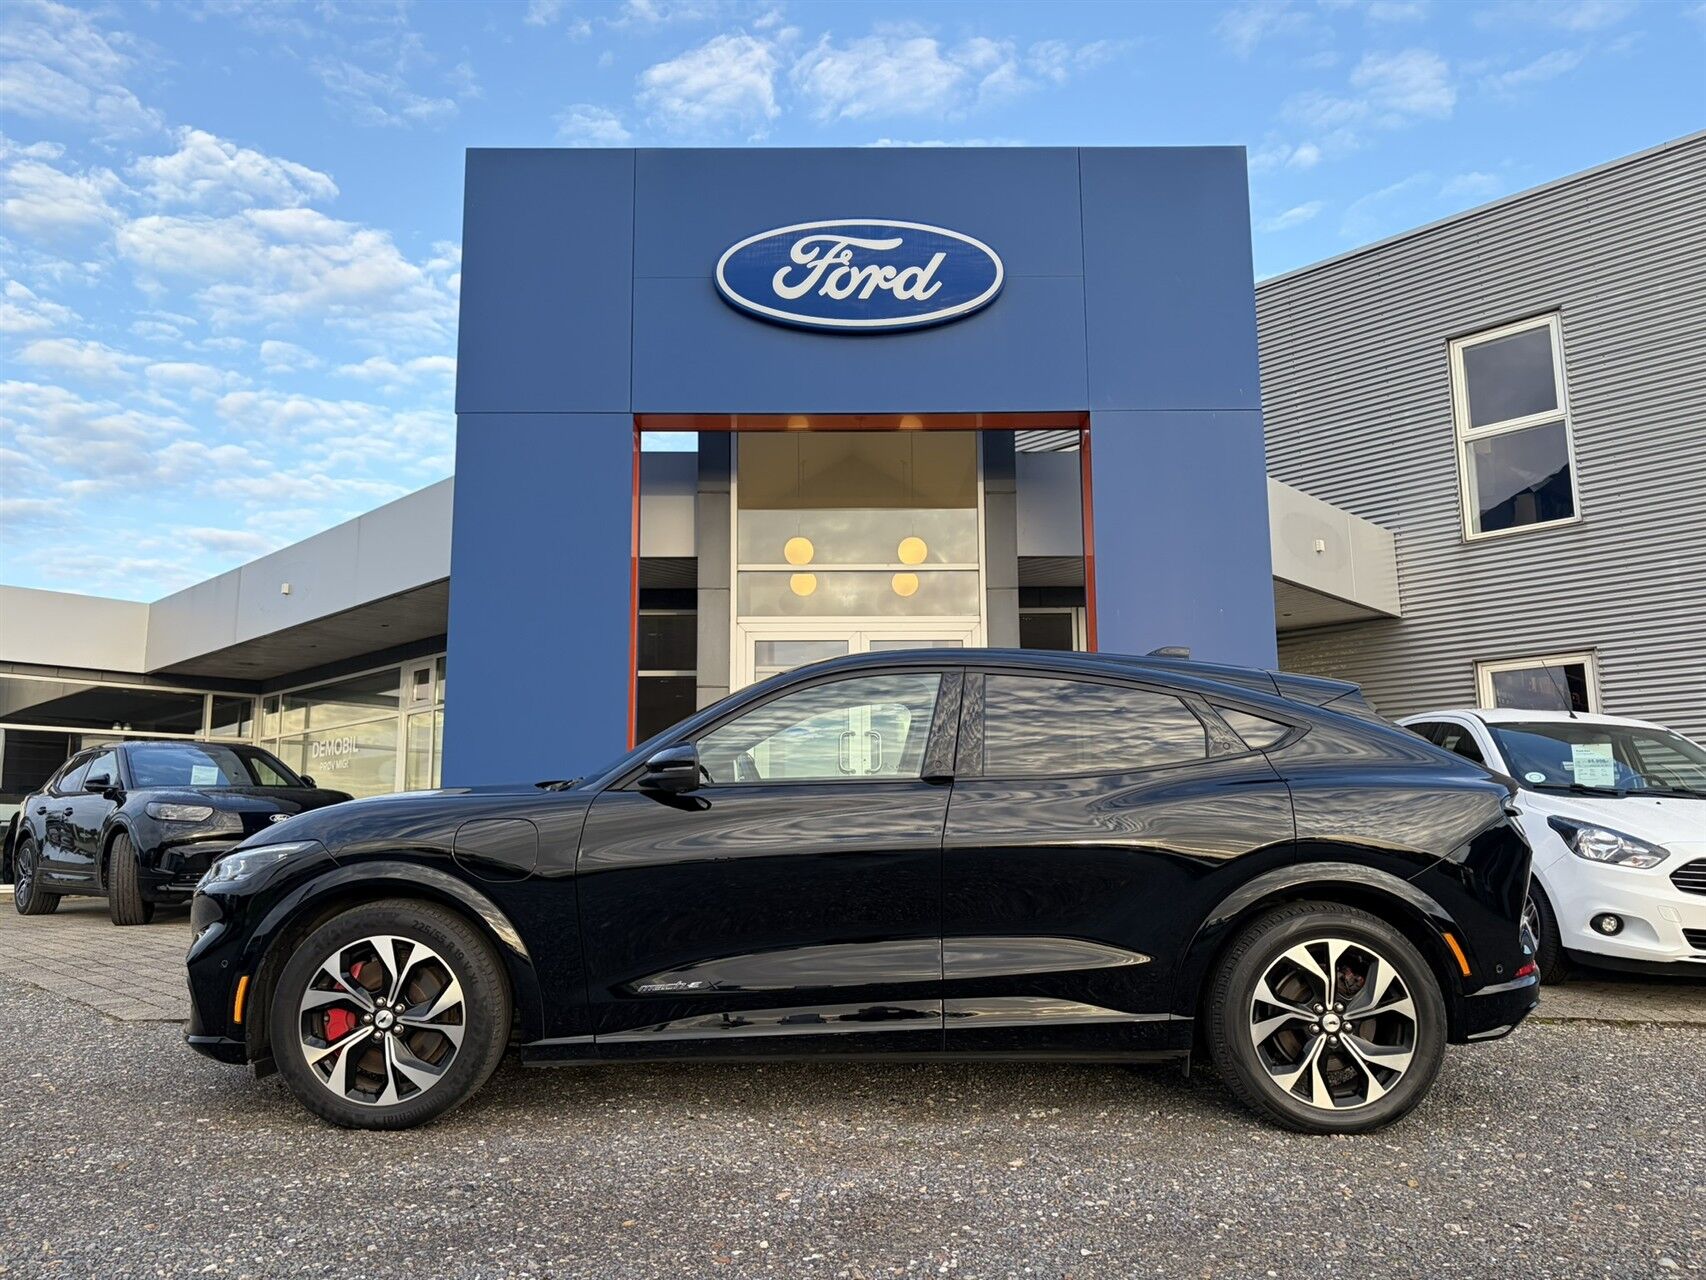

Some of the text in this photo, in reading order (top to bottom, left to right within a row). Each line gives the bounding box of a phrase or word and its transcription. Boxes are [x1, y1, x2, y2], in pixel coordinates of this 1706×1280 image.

[772, 234, 946, 300] Ford
[312, 736, 359, 758] DEMOBIL
[412, 919, 447, 944] 225/55
[446, 941, 456, 953] R
